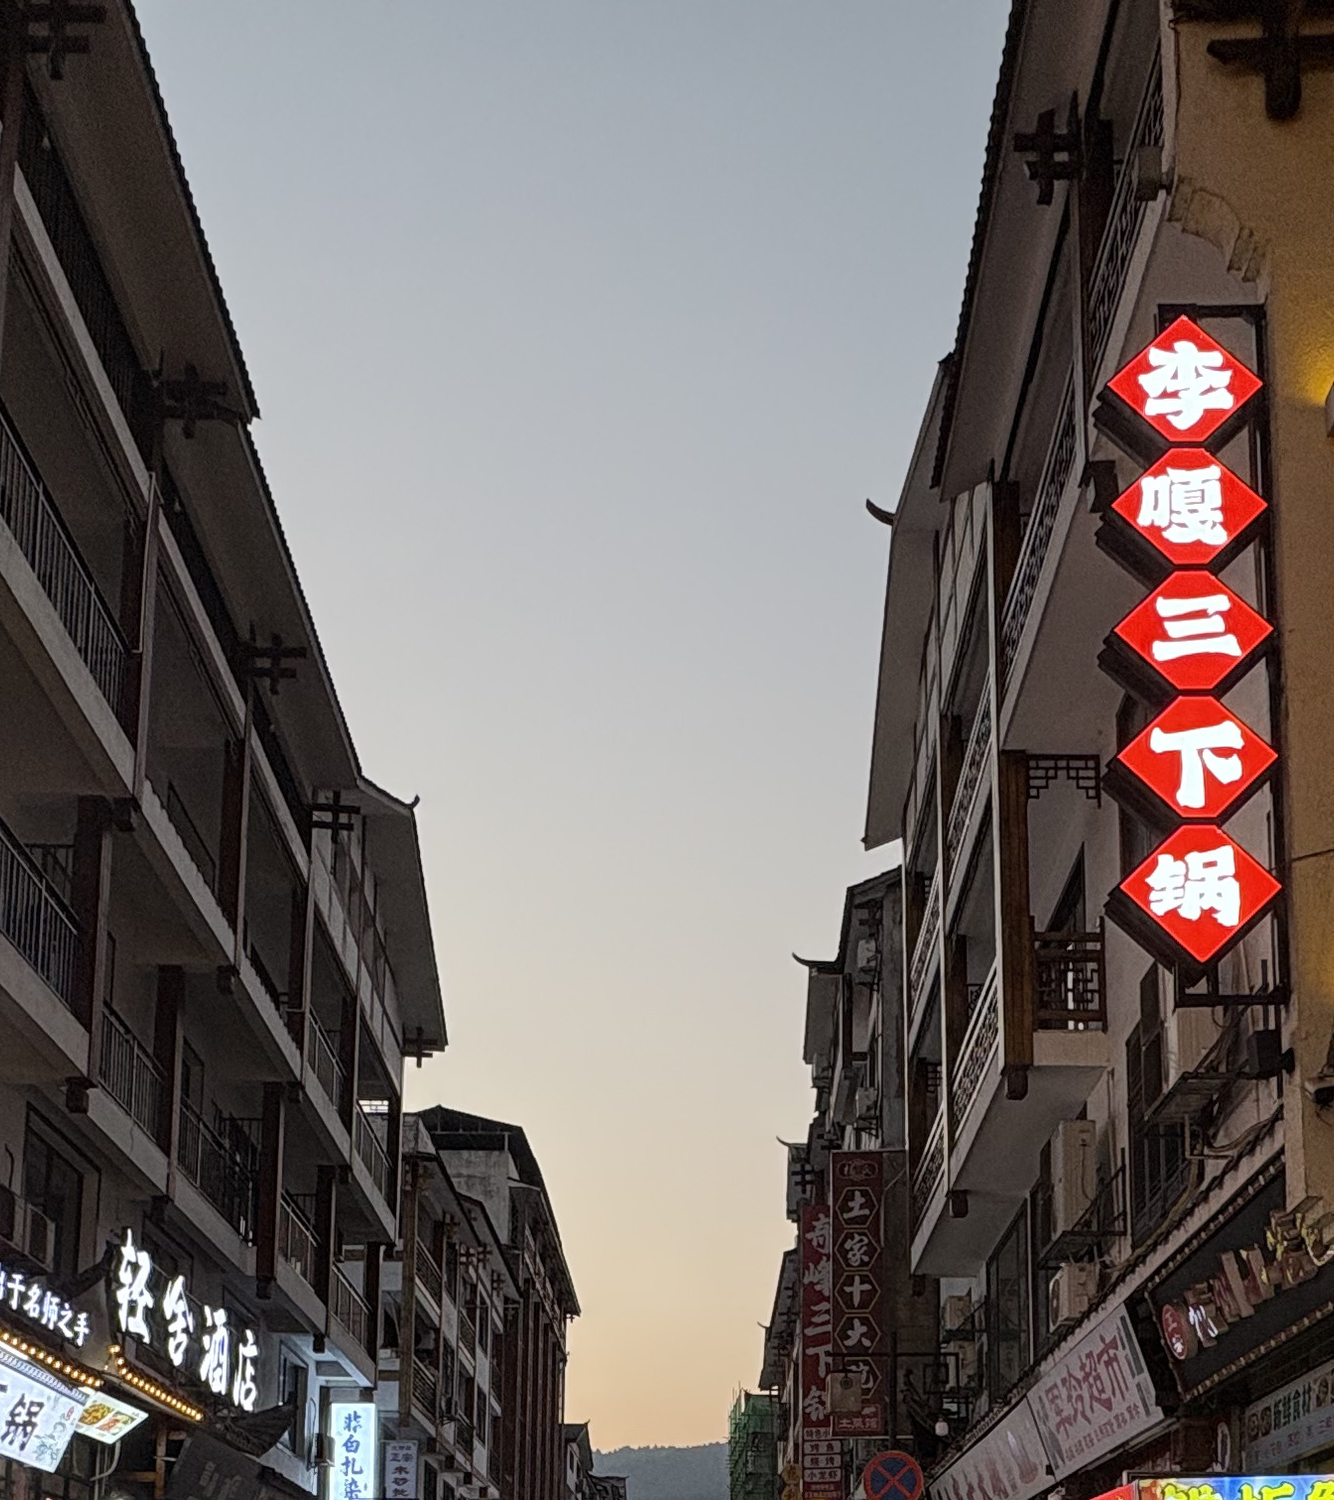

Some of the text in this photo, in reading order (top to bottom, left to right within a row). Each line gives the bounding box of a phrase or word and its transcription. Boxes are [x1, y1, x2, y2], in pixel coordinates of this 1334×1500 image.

[1137, 341, 1245, 927] 李嘎三下锅
